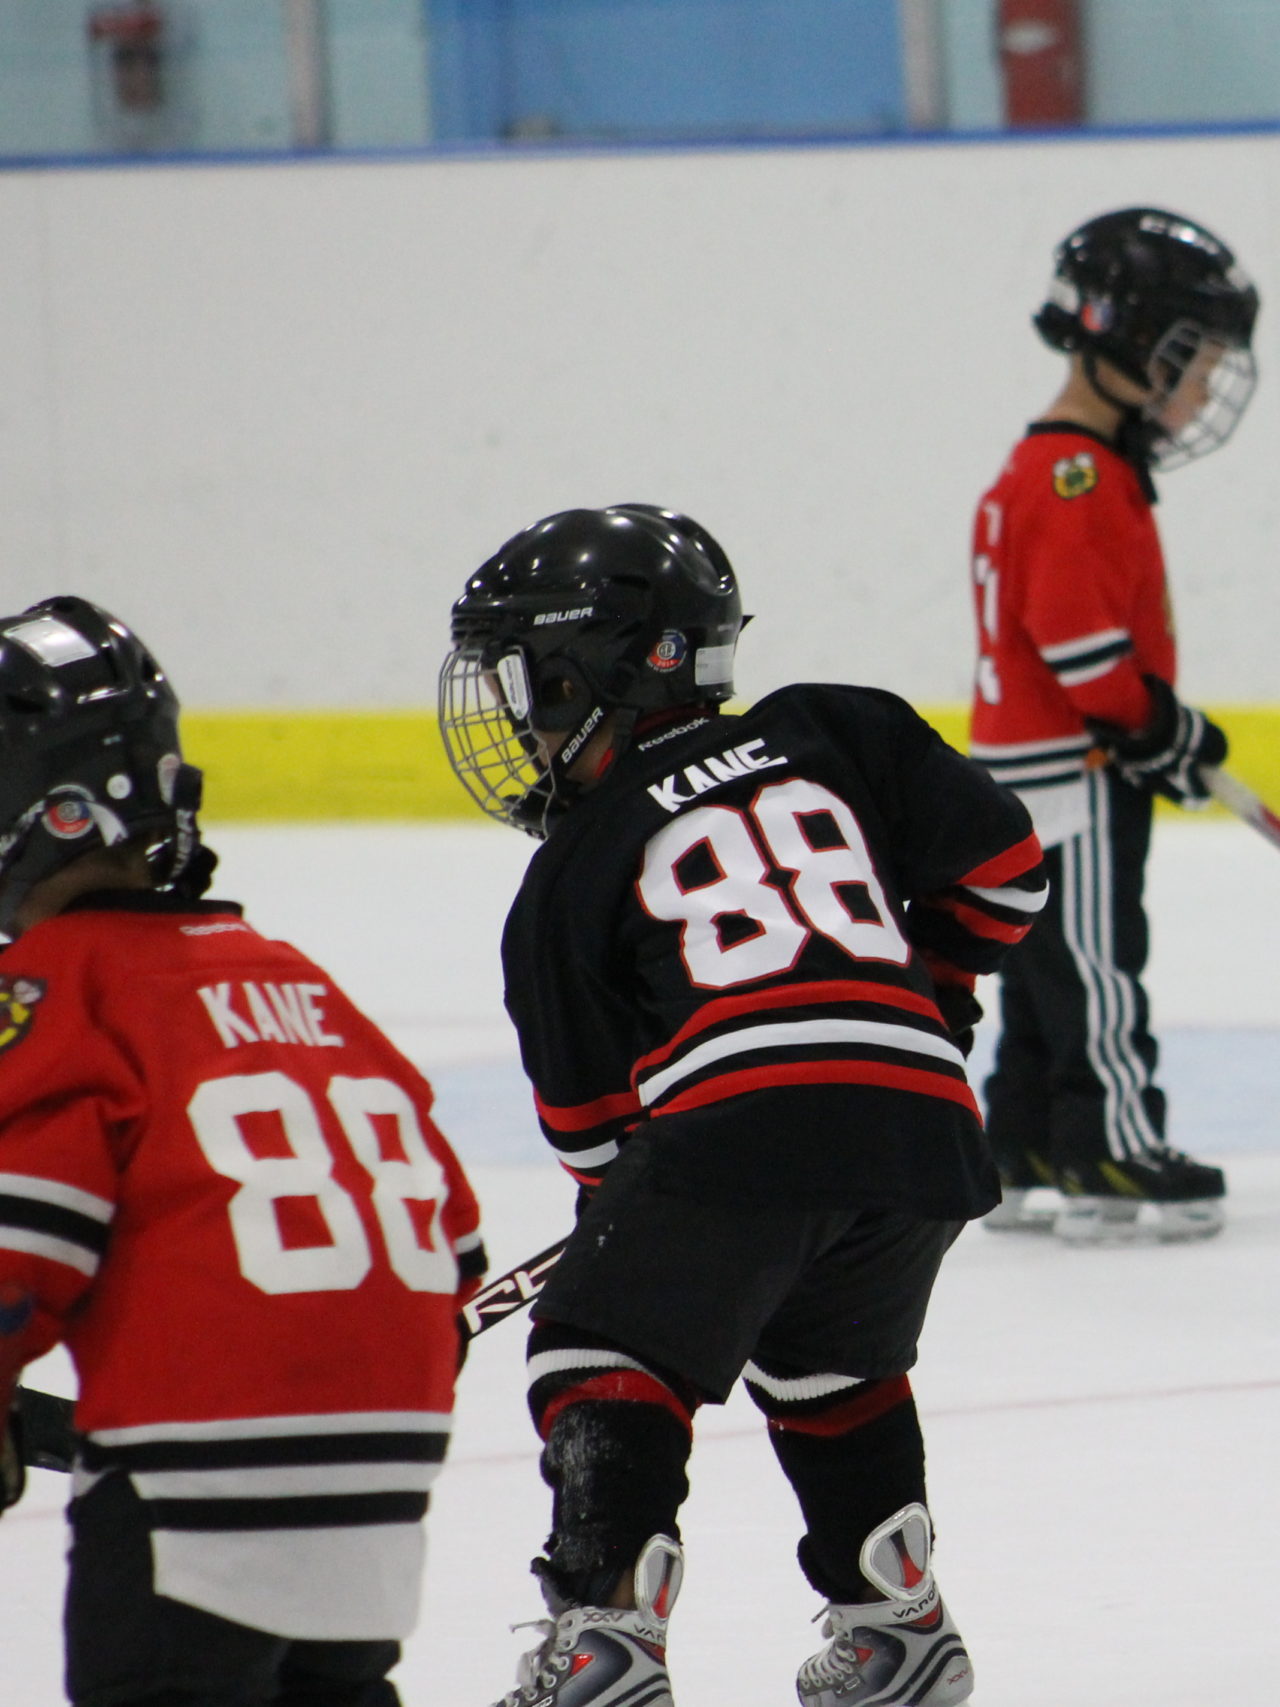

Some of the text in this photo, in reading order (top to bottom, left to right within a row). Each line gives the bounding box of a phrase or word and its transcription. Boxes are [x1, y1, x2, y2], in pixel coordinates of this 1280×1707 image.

[533, 606, 594, 626] BAUER
[561, 706, 604, 764] BAUER
[638, 716, 710, 751] Reebok
[646, 737, 788, 814] KANE
[636, 778, 912, 991] 88
[197, 980, 344, 1049] KANE
[186, 1070, 459, 1296] 88
